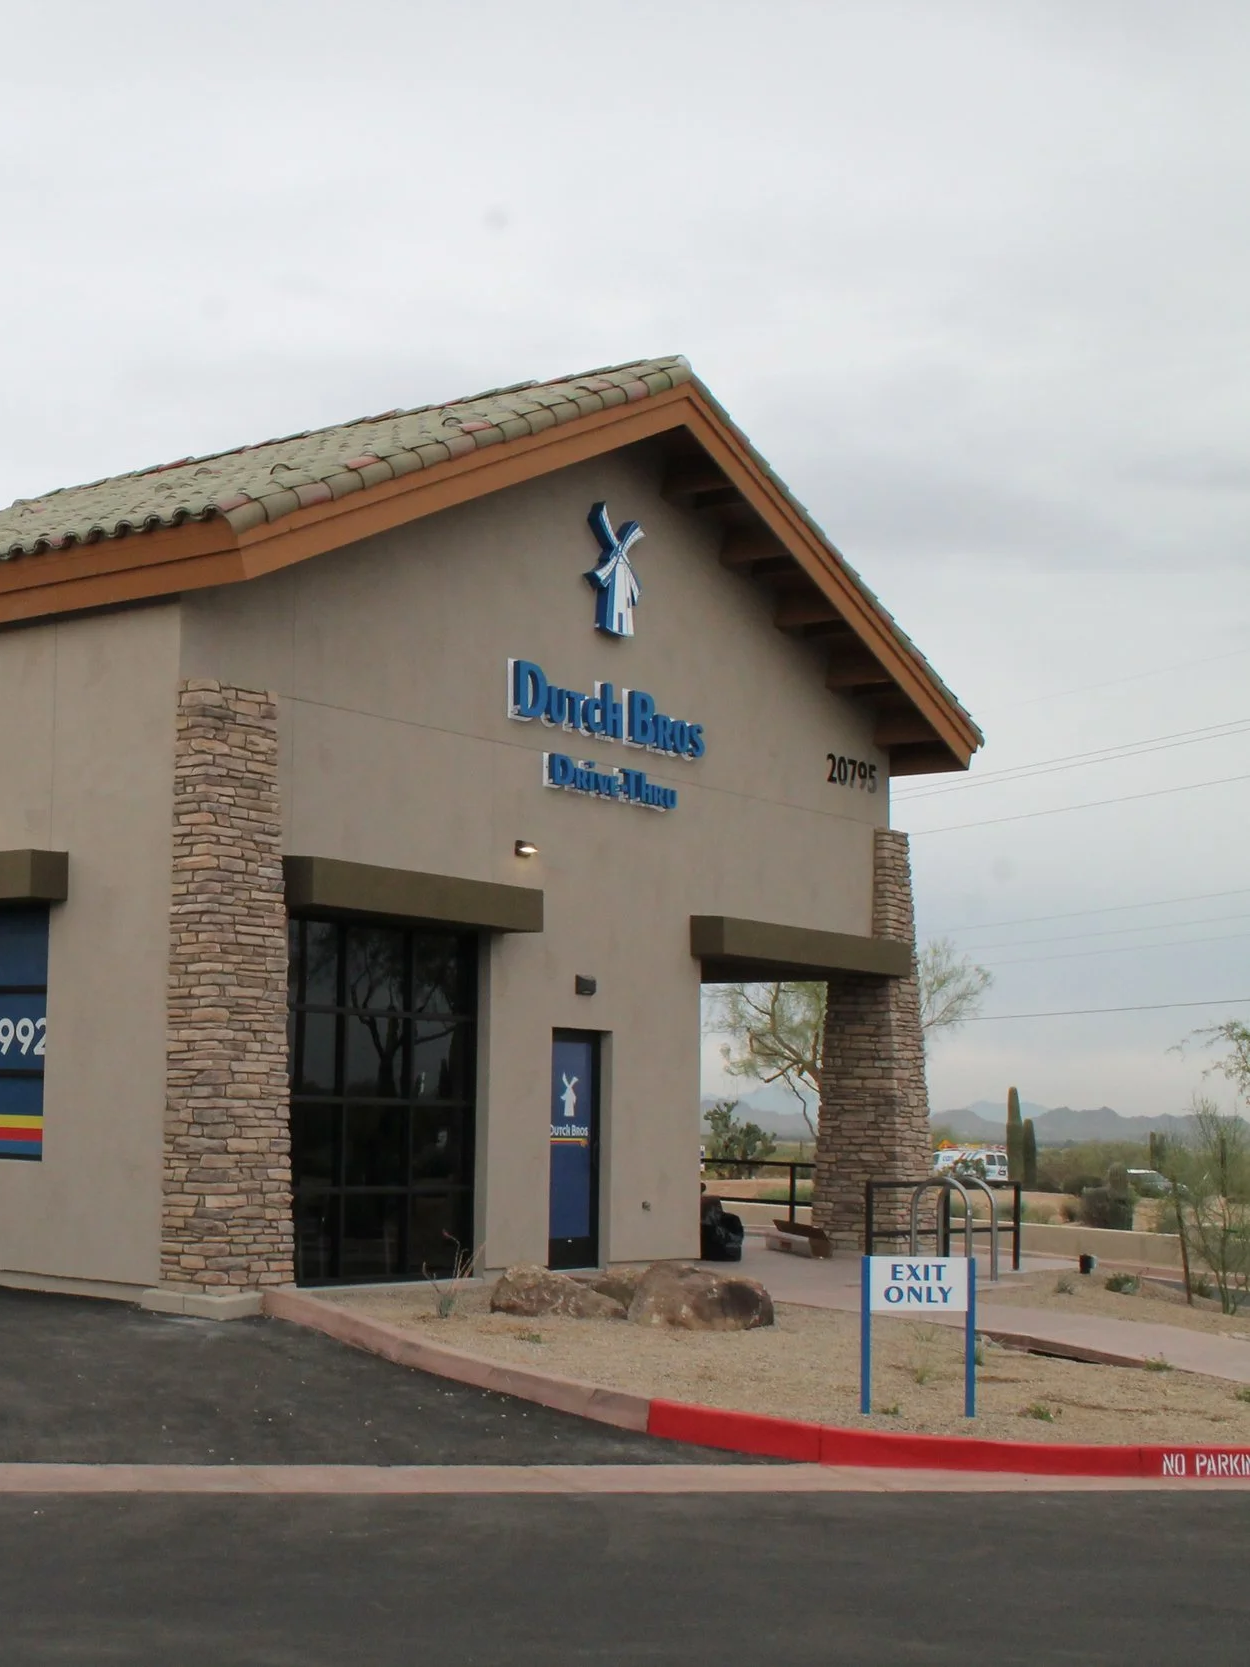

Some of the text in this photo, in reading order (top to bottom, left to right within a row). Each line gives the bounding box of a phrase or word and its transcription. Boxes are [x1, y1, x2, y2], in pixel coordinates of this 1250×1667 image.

[507, 657, 705, 761] Dutch Bros
[826, 753, 877, 793] 20795
[891, 1264, 947, 1281] EXIT
[884, 1286, 953, 1303] ONLY
[1163, 1453, 1185, 1475] NO
